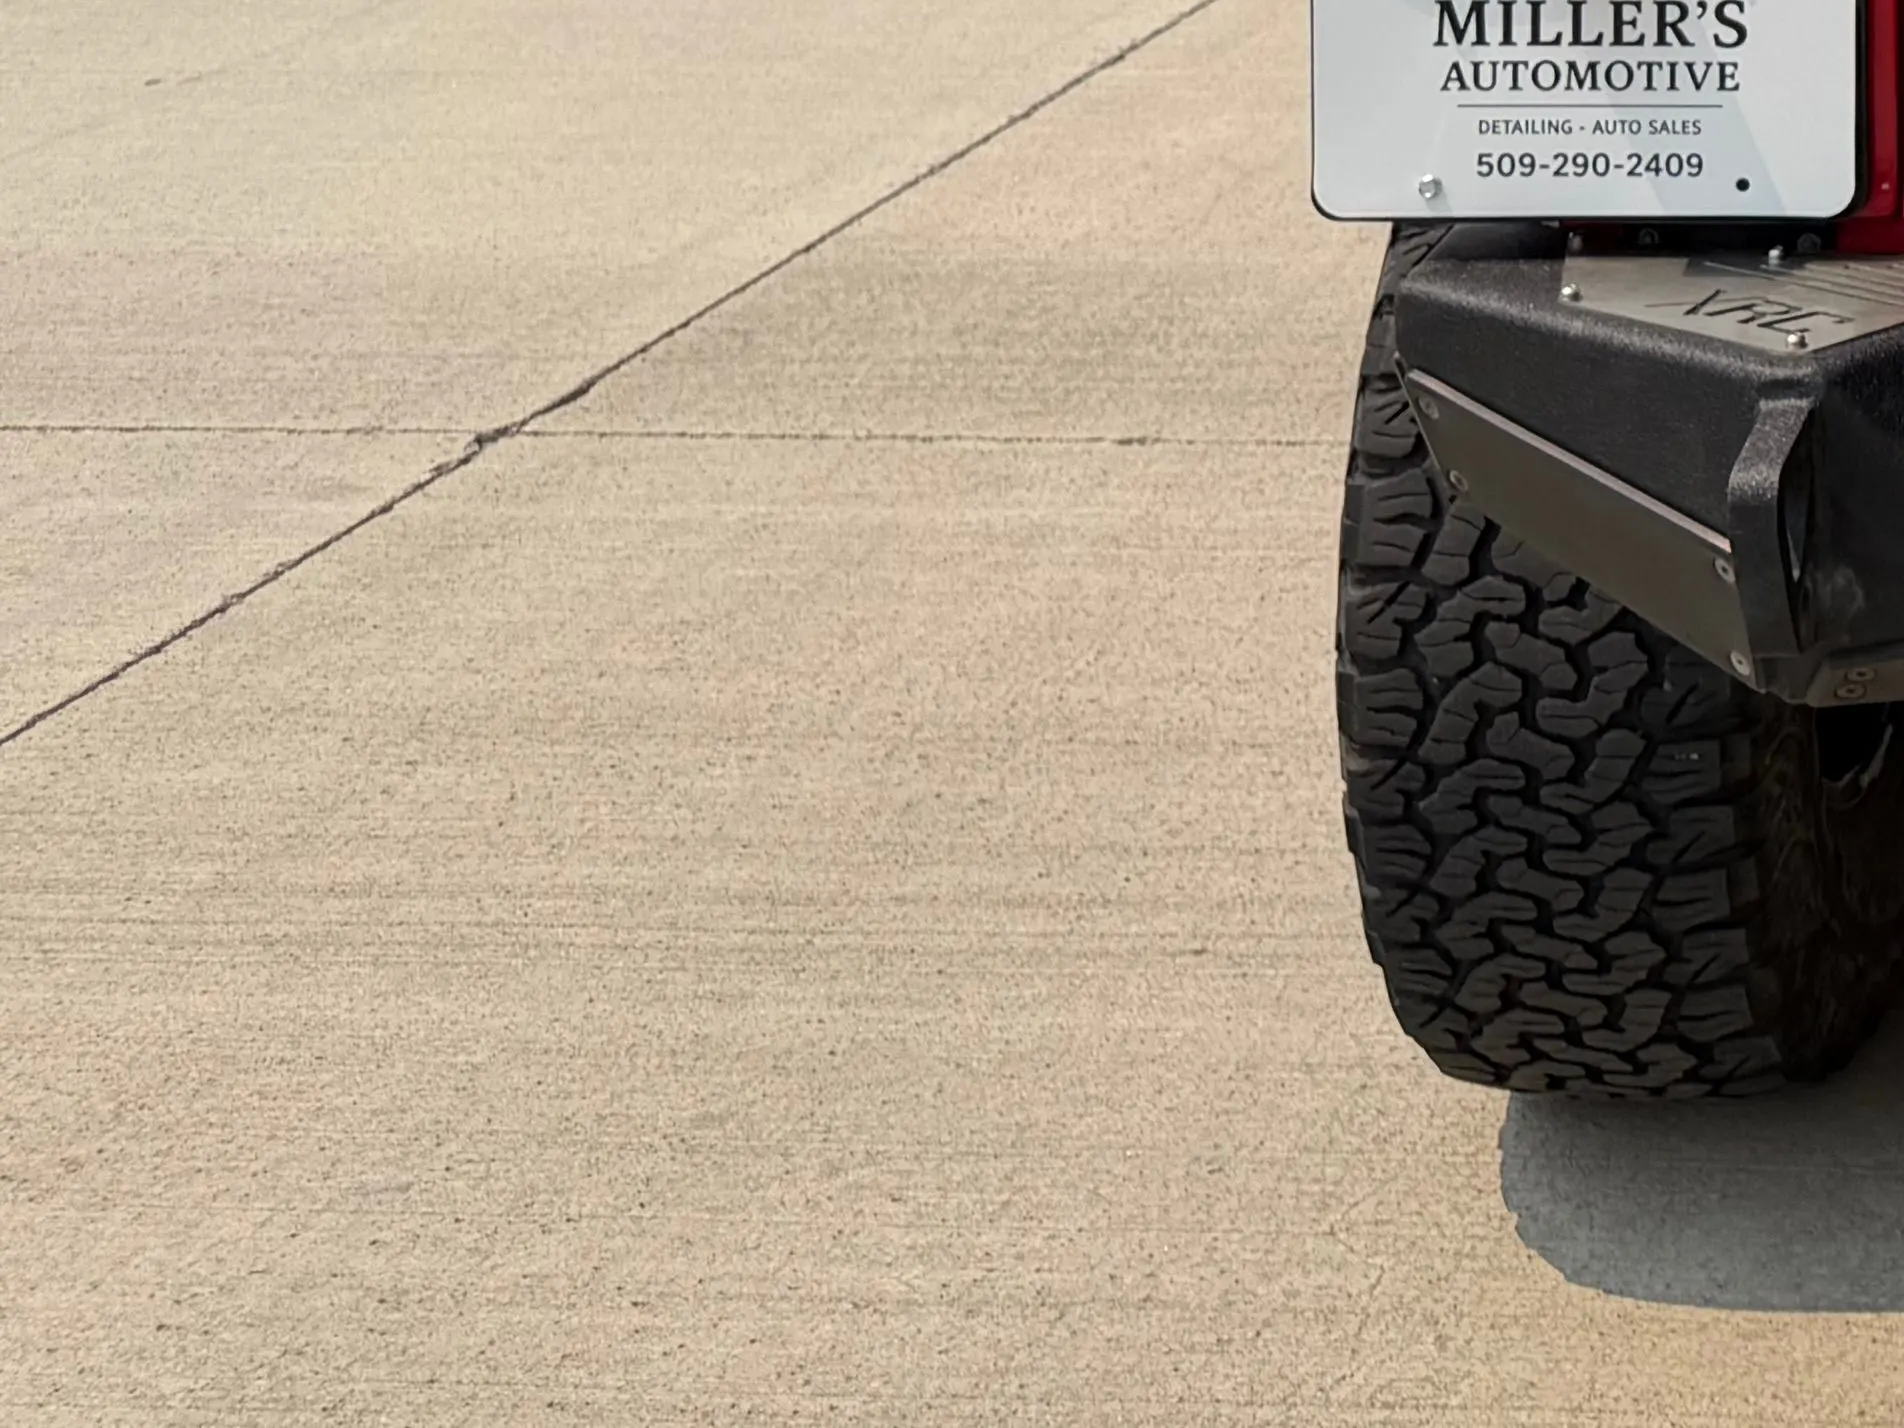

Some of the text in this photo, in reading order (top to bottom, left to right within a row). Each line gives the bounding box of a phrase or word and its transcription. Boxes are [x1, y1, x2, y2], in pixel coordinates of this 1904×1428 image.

[1433, 0, 1748, 48] MILLER'S
[1440, 59, 1740, 92] AUTOMOTIVE
[1478, 119, 1573, 136] DETAILING
[1592, 119, 1642, 136] AUTO
[1648, 119, 1702, 136] SALES
[1476, 152, 1704, 178] 509-290-2409
